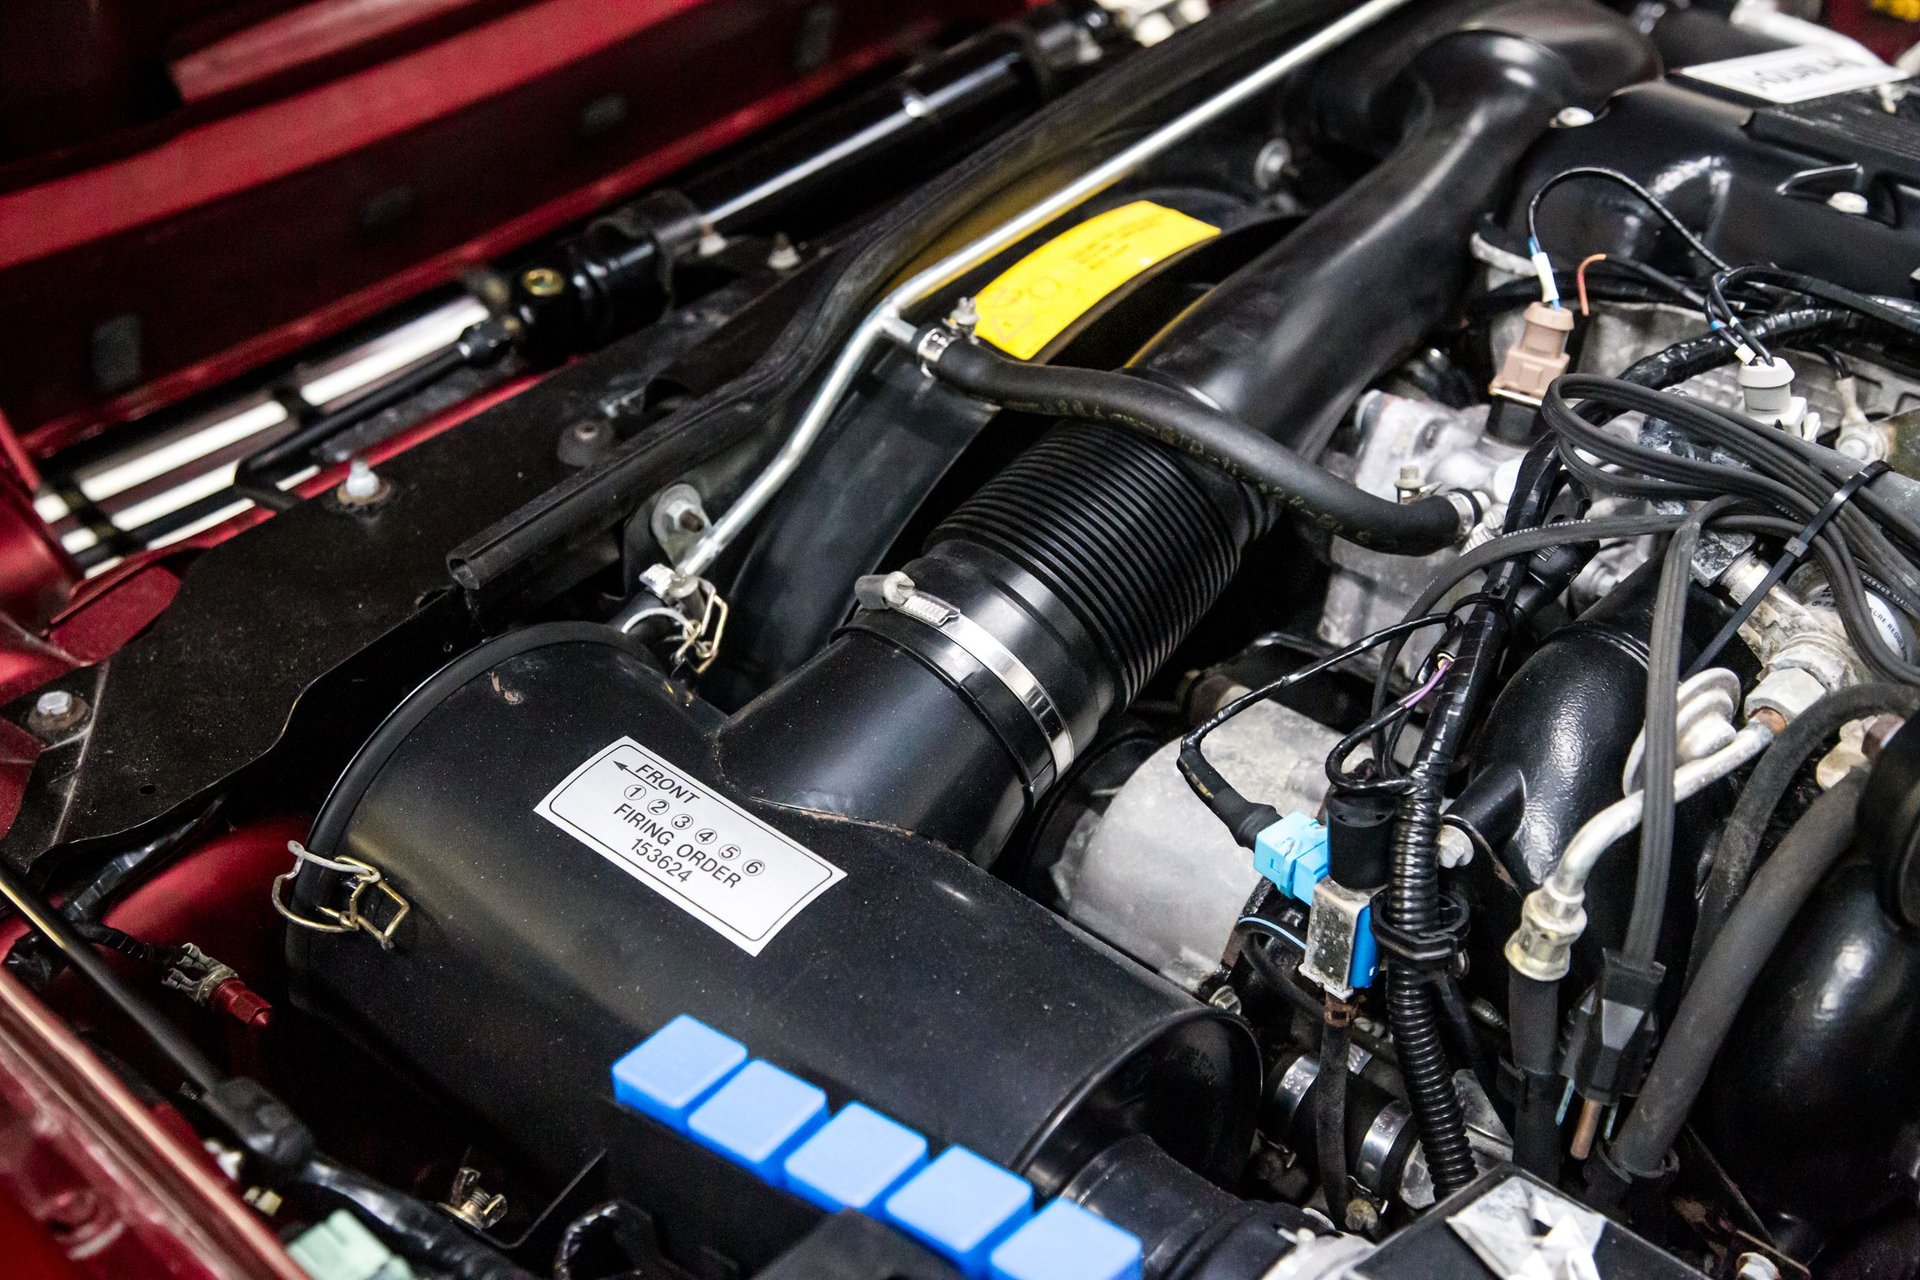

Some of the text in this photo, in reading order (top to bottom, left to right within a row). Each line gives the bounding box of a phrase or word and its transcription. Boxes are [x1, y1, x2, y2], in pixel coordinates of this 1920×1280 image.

[635, 764, 700, 803] FRONT
[613, 803, 741, 888] FIRING ORDER
[631, 839, 692, 882] 153624
